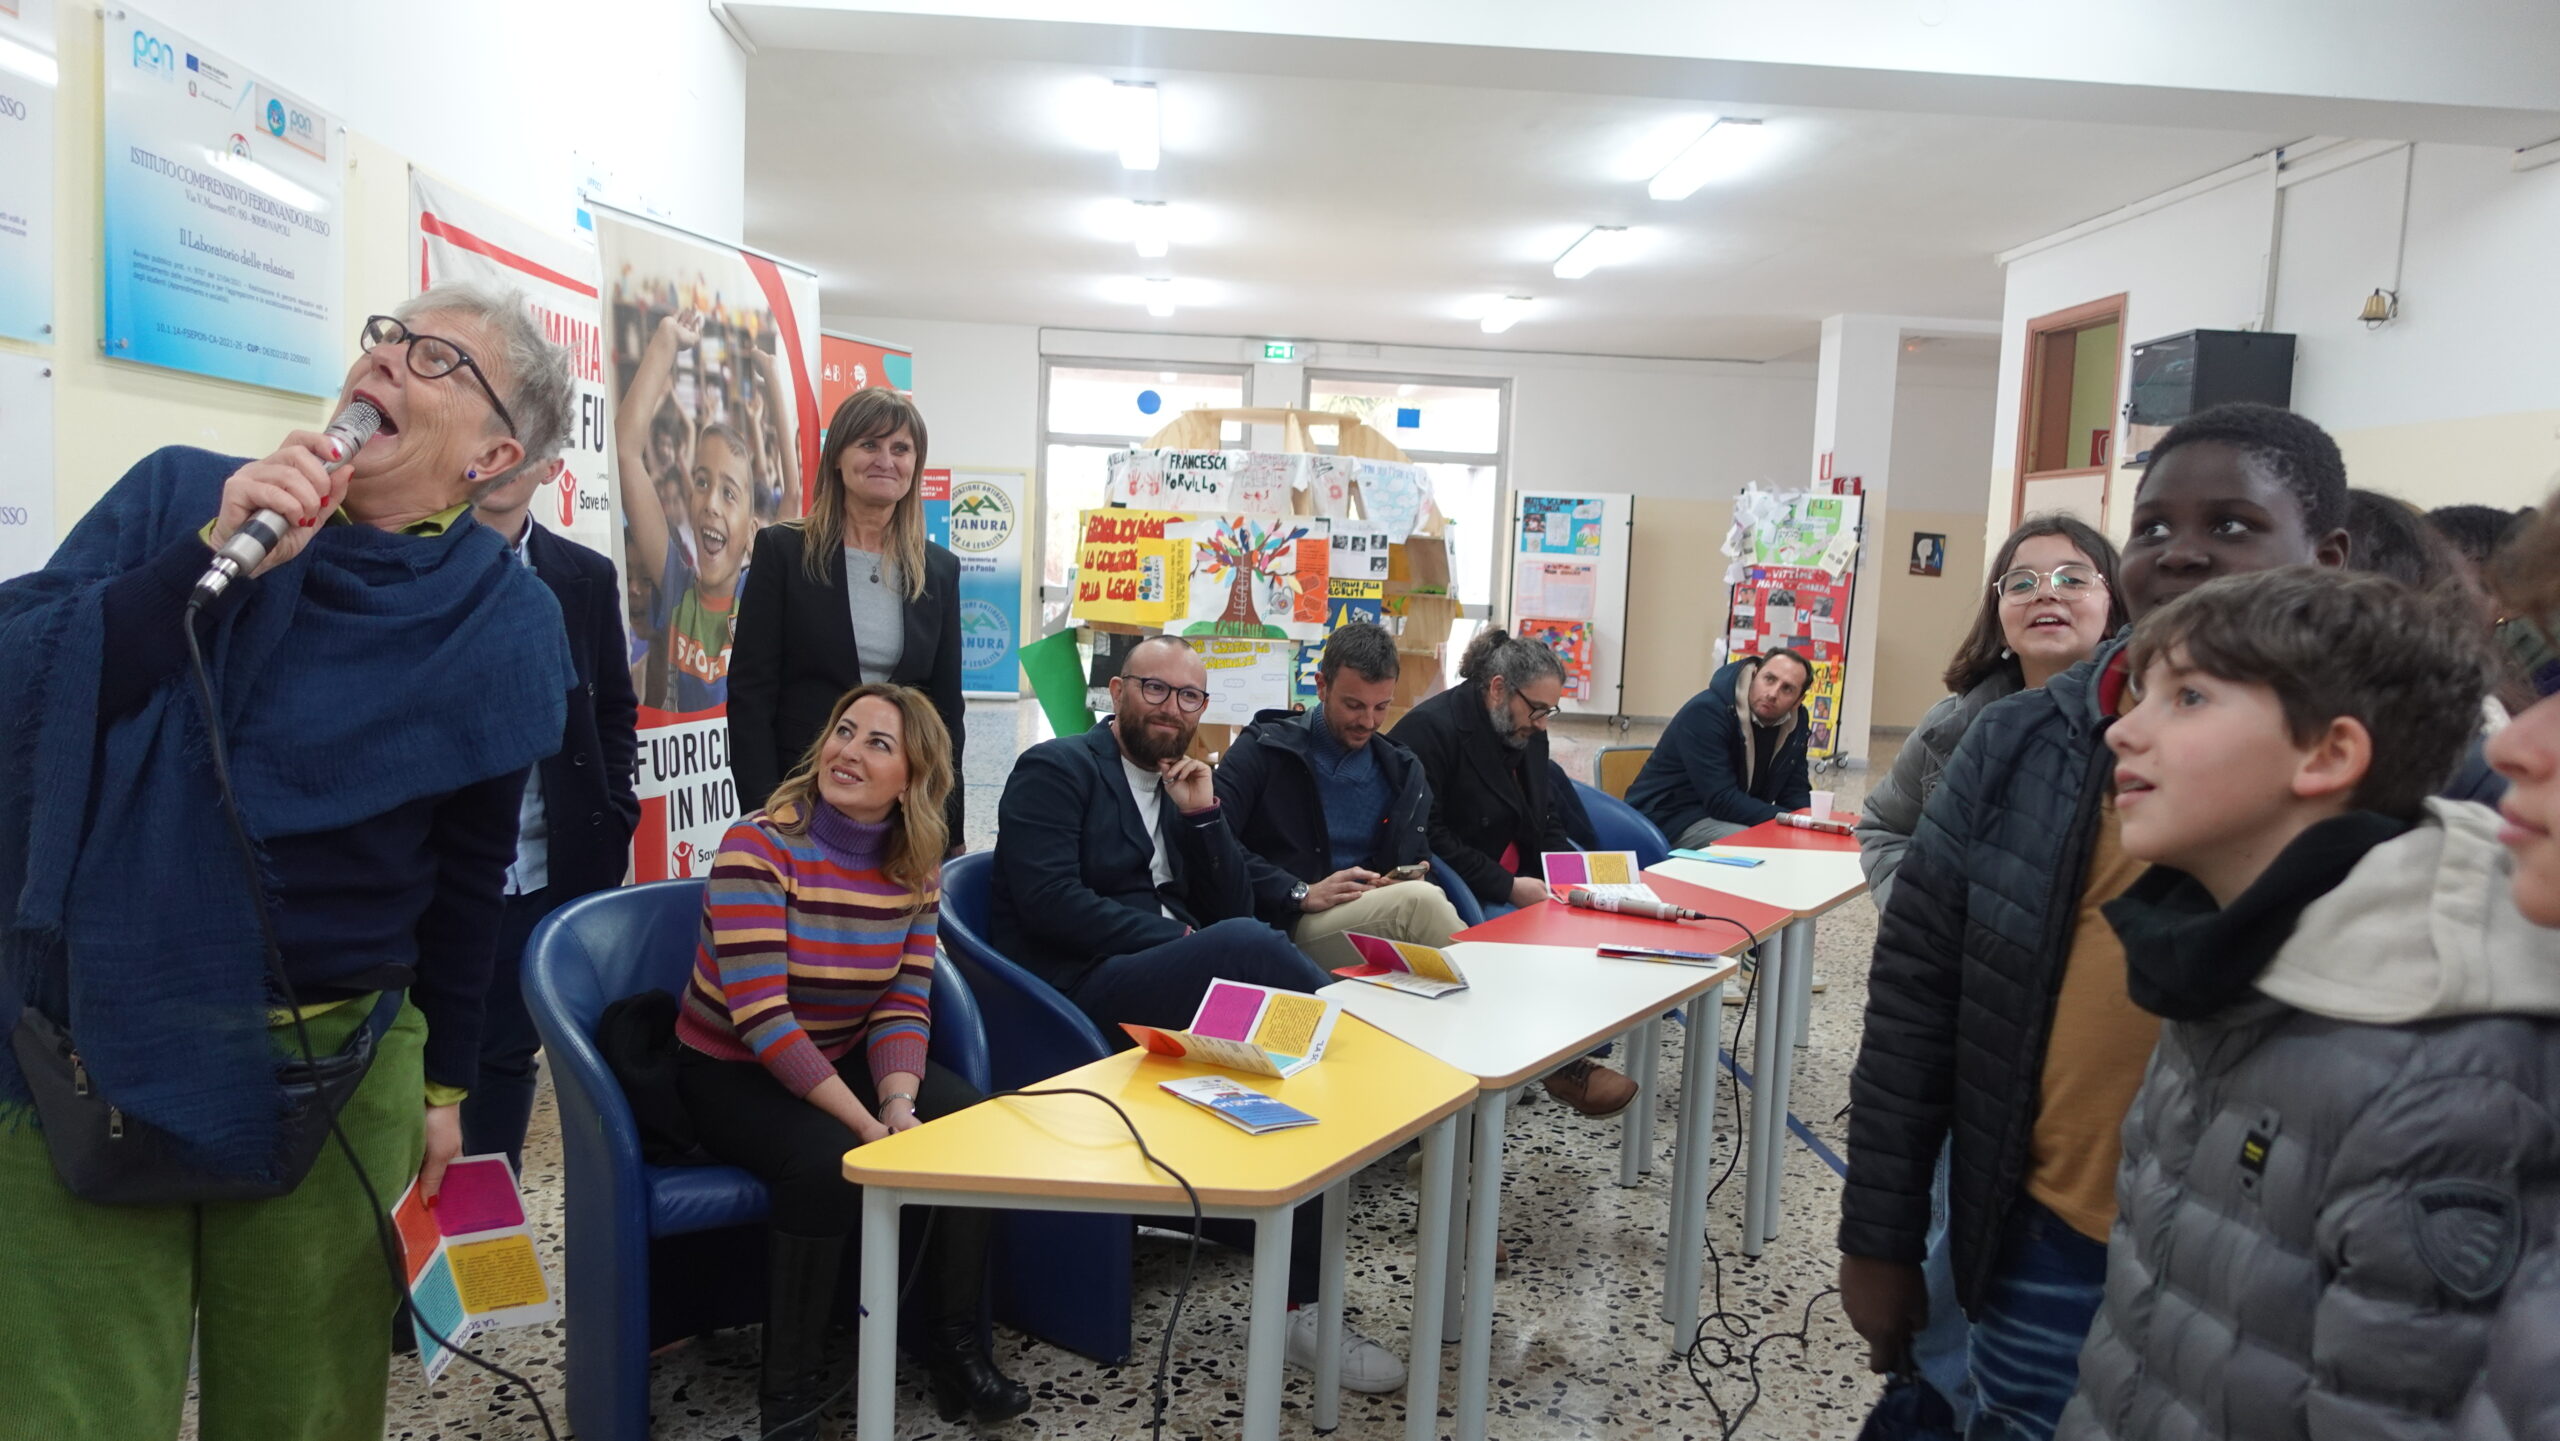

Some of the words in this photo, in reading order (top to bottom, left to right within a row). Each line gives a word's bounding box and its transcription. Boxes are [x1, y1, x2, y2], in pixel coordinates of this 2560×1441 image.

[134, 30, 174, 72] pon
[289, 109, 312, 133] pon
[131, 146, 176, 178] ISTITUTO
[177, 165, 247, 206] COMPRENSIVO
[249, 191, 304, 228] FERDINANDO
[305, 213, 331, 237] RUSSO
[179, 228, 188, 246] Il
[188, 230, 240, 263] Laboratorio
[240, 248, 262, 271] delle
[262, 256, 295, 280] relazioni
[1170, 454, 1227, 470] FRANCESCA
[579, 489, 600, 511] Save
[951, 518, 1008, 531] IANURA
[975, 565, 996, 573] Paolo
[670, 786, 694, 833] IN
[702, 778, 735, 825] MO
